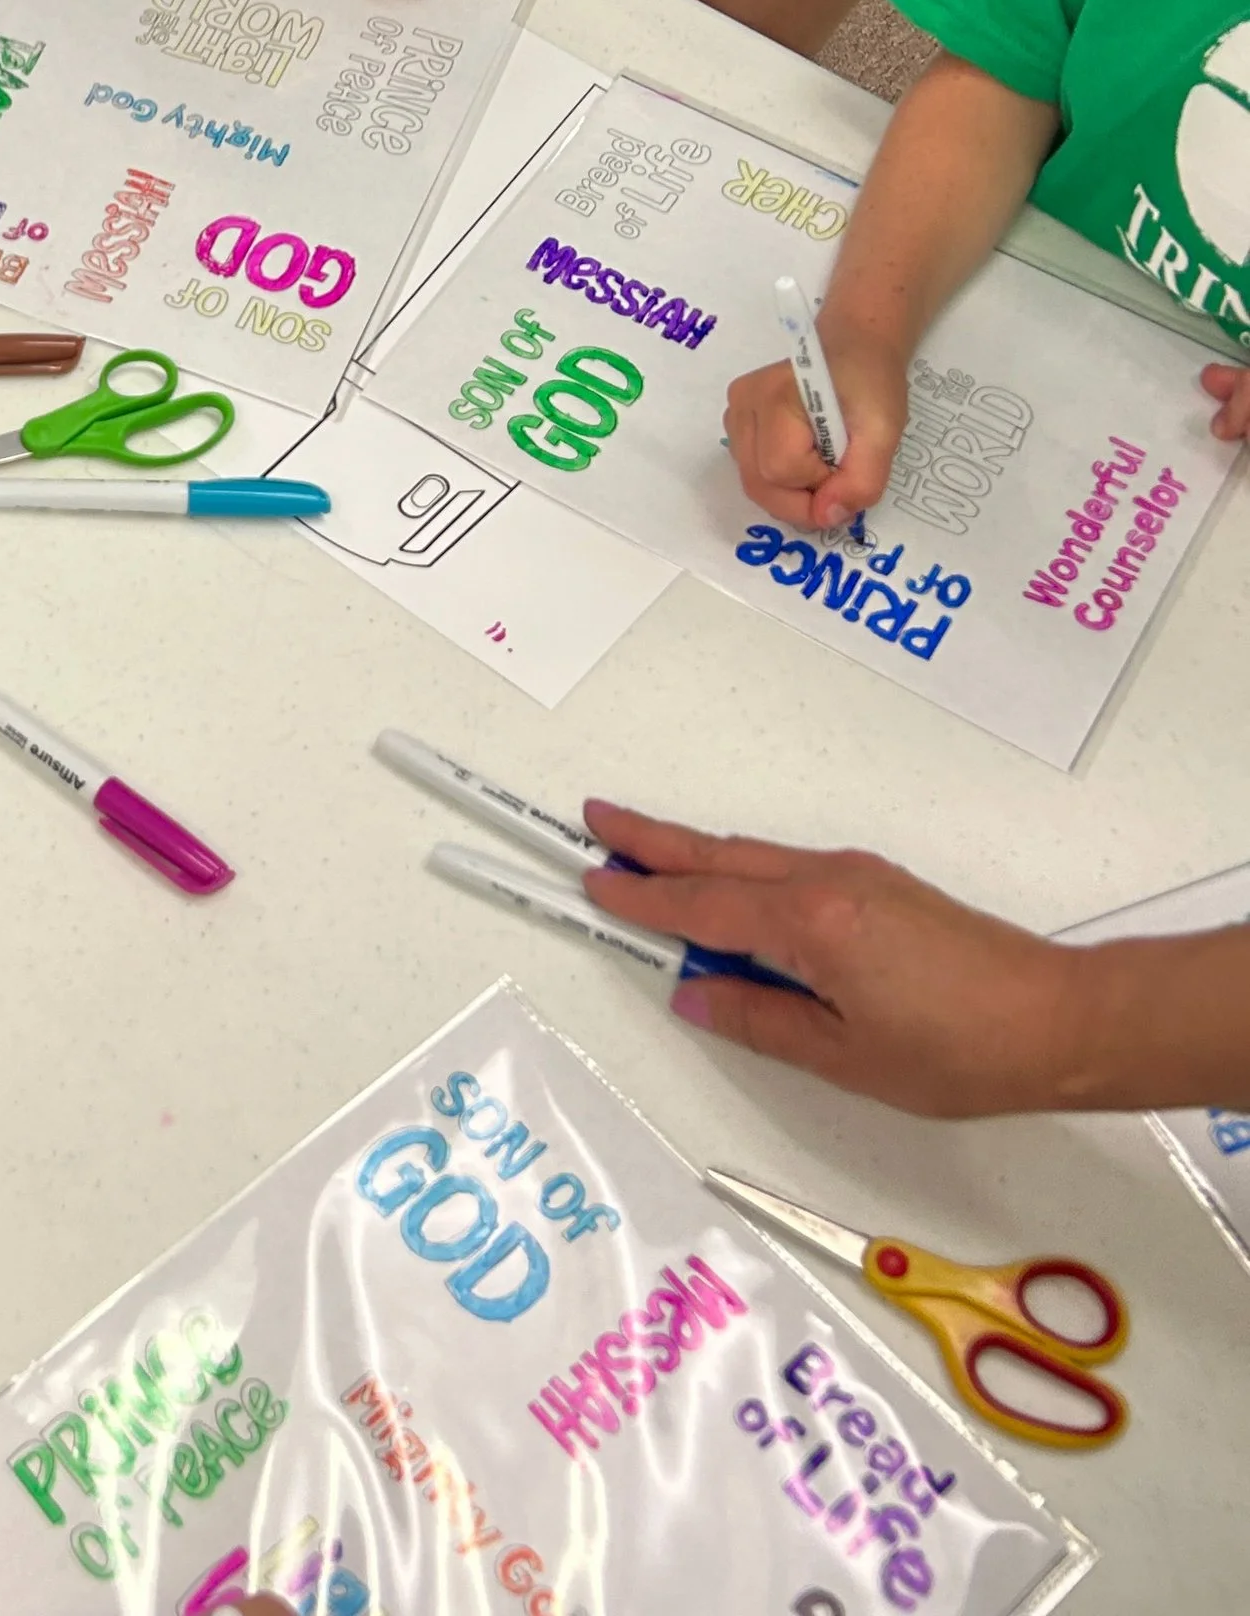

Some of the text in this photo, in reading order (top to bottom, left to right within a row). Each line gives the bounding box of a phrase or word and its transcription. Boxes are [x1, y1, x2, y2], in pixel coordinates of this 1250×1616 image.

[83, 81, 291, 168] Mighty God
[554, 127, 647, 219] Bread
[613, 137, 713, 242] of Life
[721, 157, 849, 242] CHeR
[195, 214, 357, 309] GOD
[235, 295, 333, 353] SON
[447, 355, 529, 431] SON
[506, 345, 645, 473] GOD
[892, 384, 1036, 536] WORLD
[1022, 435, 1147, 609] Wonderful
[1072, 466, 1188, 632] Counselor
[30, 744, 86, 791] Affisure
[430, 1070, 548, 1181] SON
[355, 1124, 551, 1324] GOD
